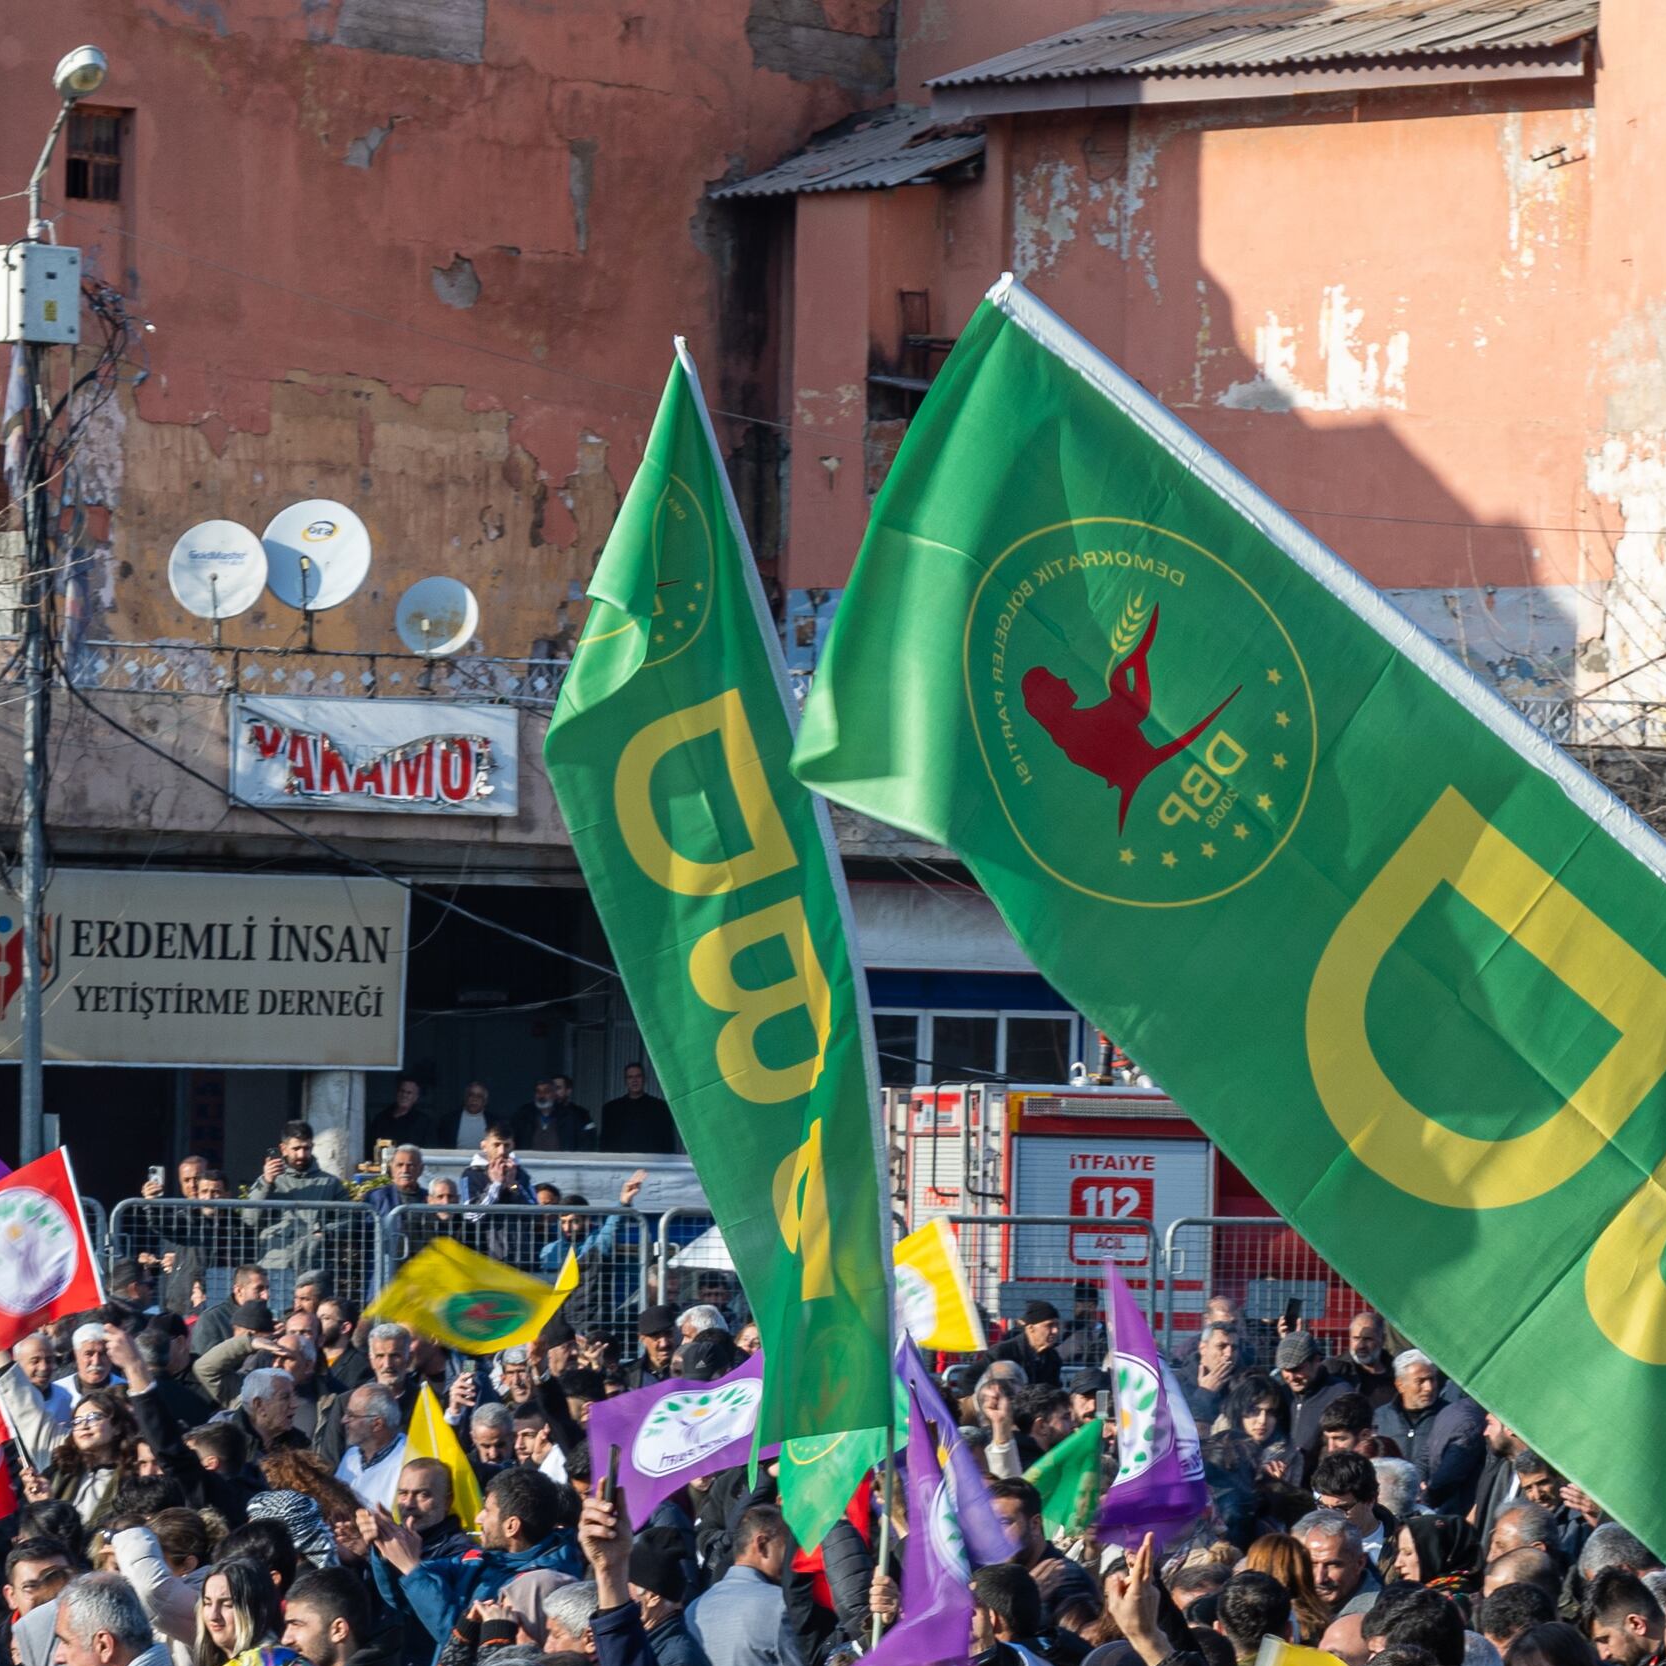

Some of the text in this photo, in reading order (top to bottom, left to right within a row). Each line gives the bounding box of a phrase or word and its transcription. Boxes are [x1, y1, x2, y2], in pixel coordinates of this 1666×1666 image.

[70, 916, 391, 964] ERDEMLİ İNSAN
[74, 982, 384, 1020] YETİŞTİRME DERNEĞİ
[1081, 1185, 1141, 1220] 112
